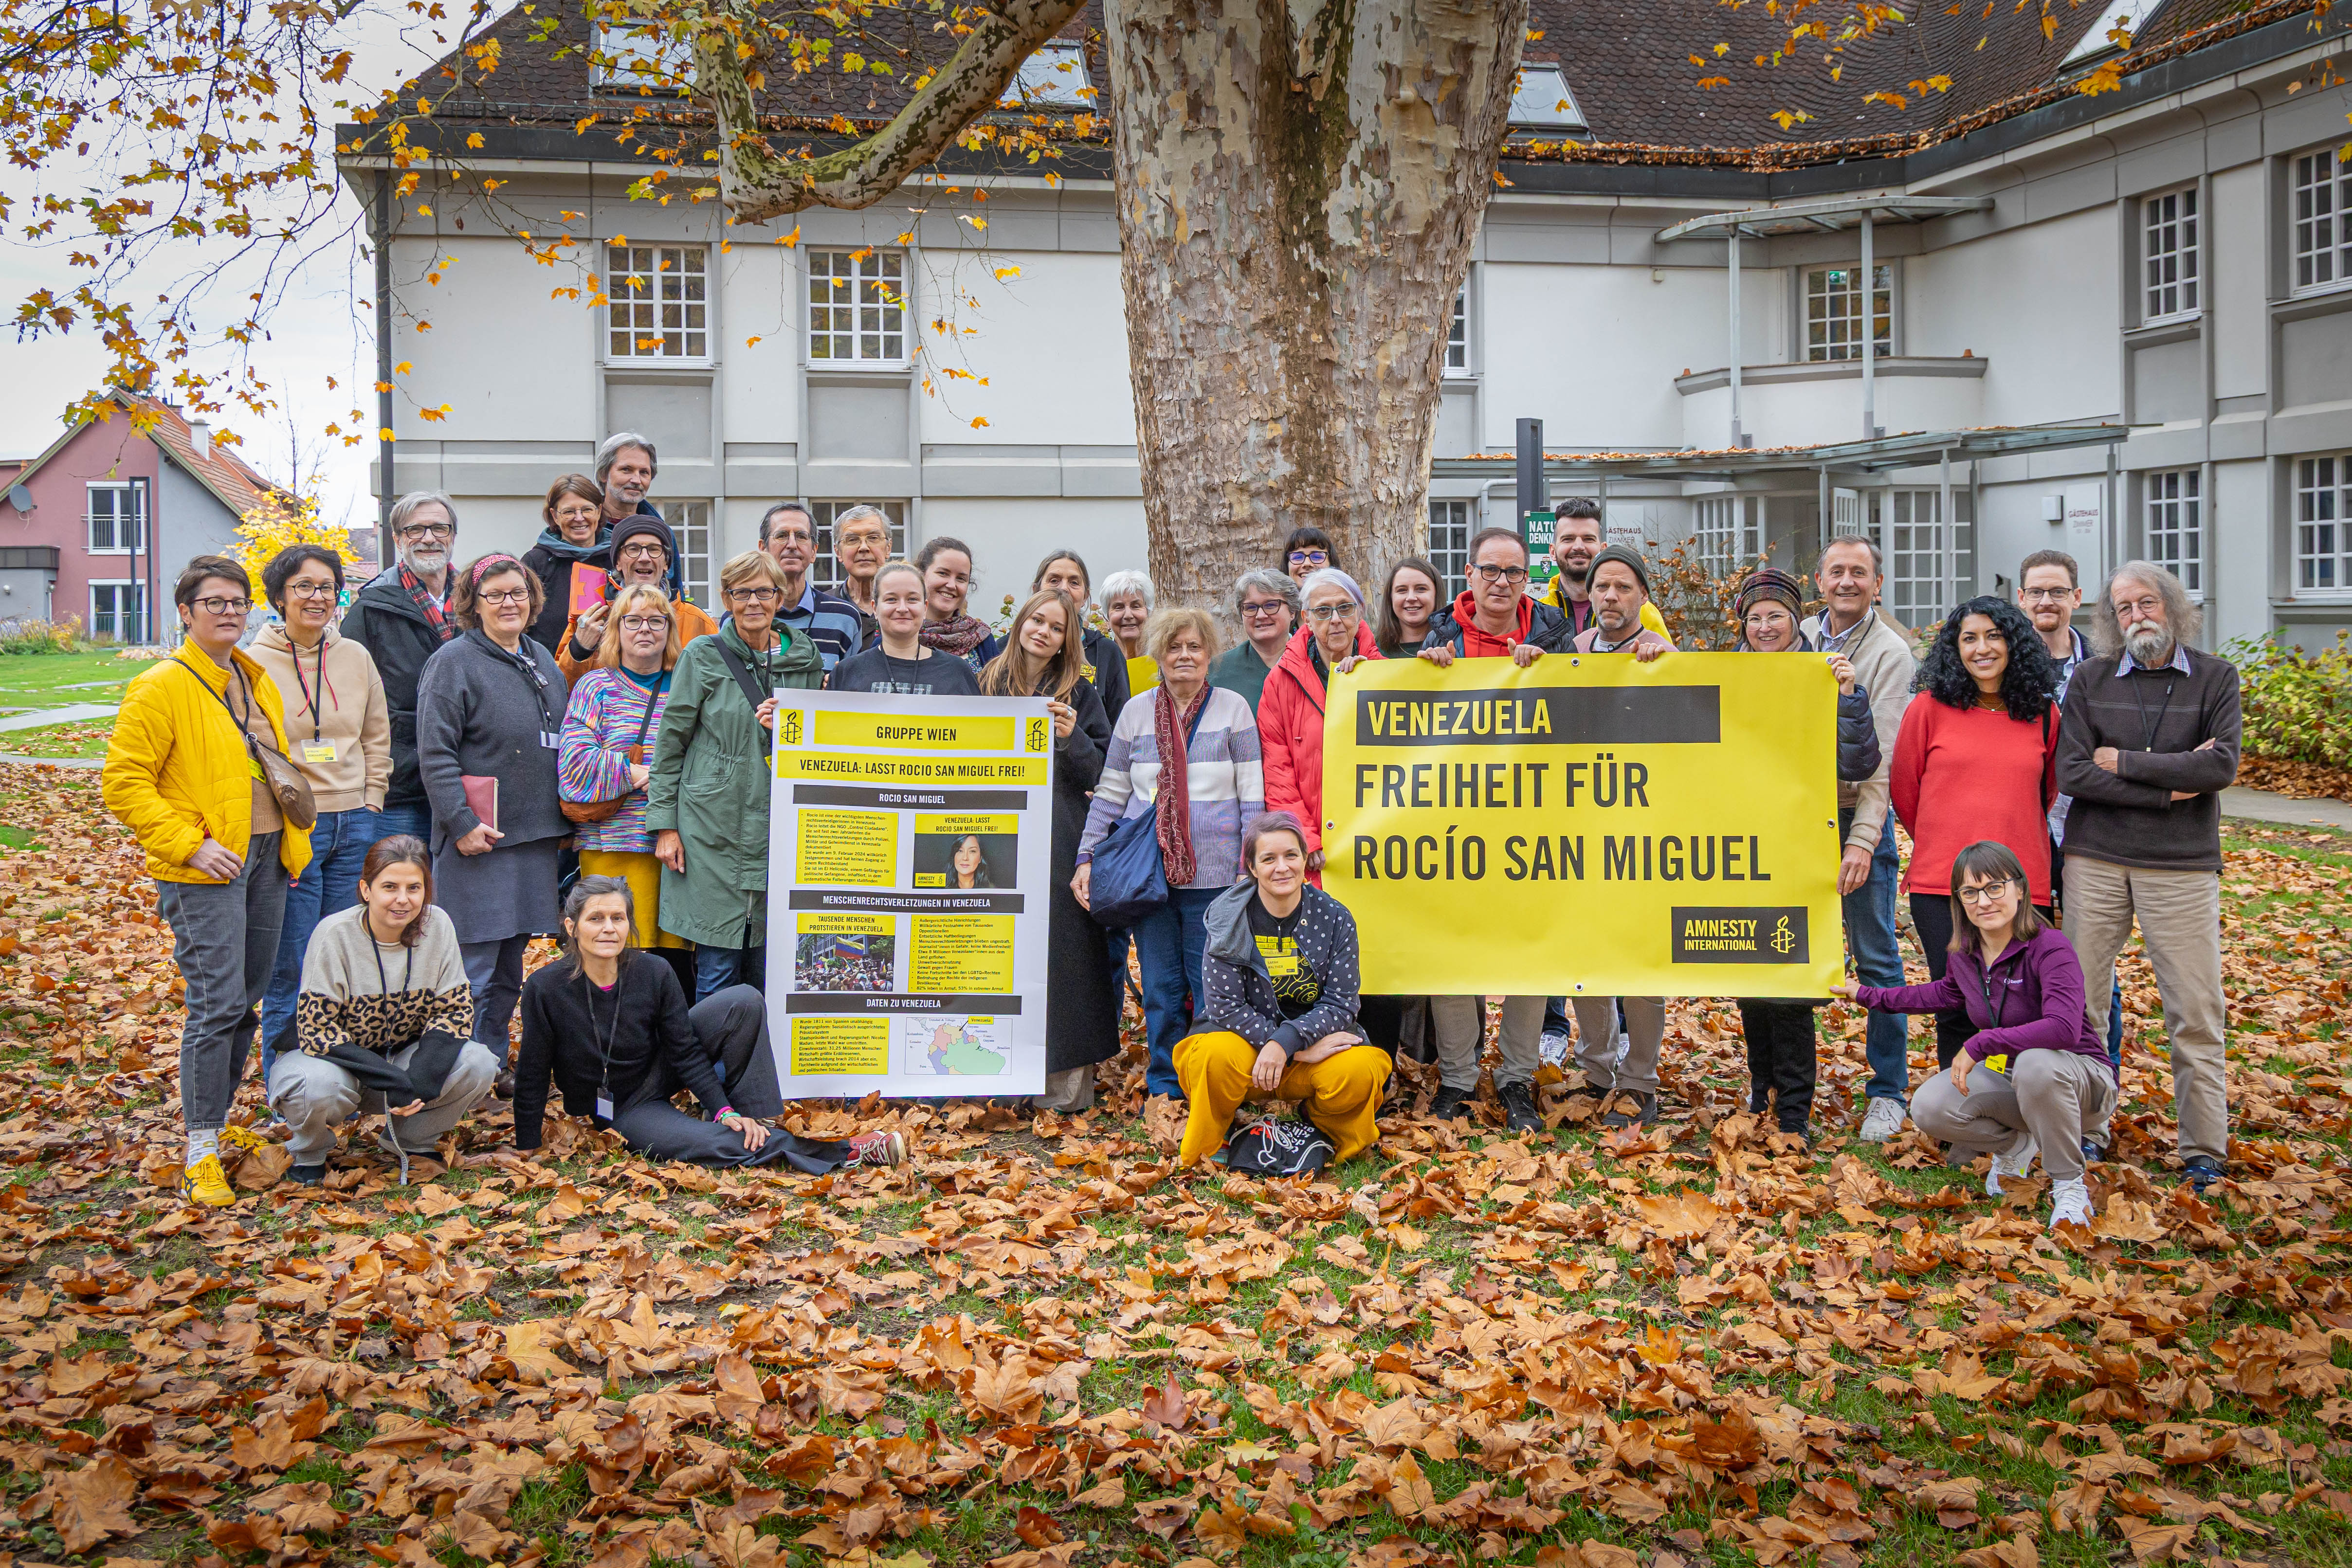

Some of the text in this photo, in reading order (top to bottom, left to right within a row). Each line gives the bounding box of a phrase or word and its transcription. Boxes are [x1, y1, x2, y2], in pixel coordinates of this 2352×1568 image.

[1529, 521, 1556, 532] NATU
[1529, 533, 1553, 544] DENKM
[1367, 699, 1552, 736] VENEZUELA
[876, 726, 956, 741] GRUPPE WIEN
[800, 759, 1024, 777] VENEZUELA: LASST ROCIO SAN MIGUEL FREI!
[1355, 753, 1650, 808] FREIHEIT FÜR
[879, 793, 946, 803] ROCIO SAN MIGUEL
[1354, 825, 1771, 881] ROCÍO SAN MIGUEL
[823, 895, 990, 907] MENSCHENRECHTSVERLETZUNGEN IN VENEZUELA
[1684, 919, 1757, 937] AMNESTY
[1685, 939, 1757, 950] INTERNATIONAL
[866, 999, 941, 1008] DATEN ZU VENEZUELA
